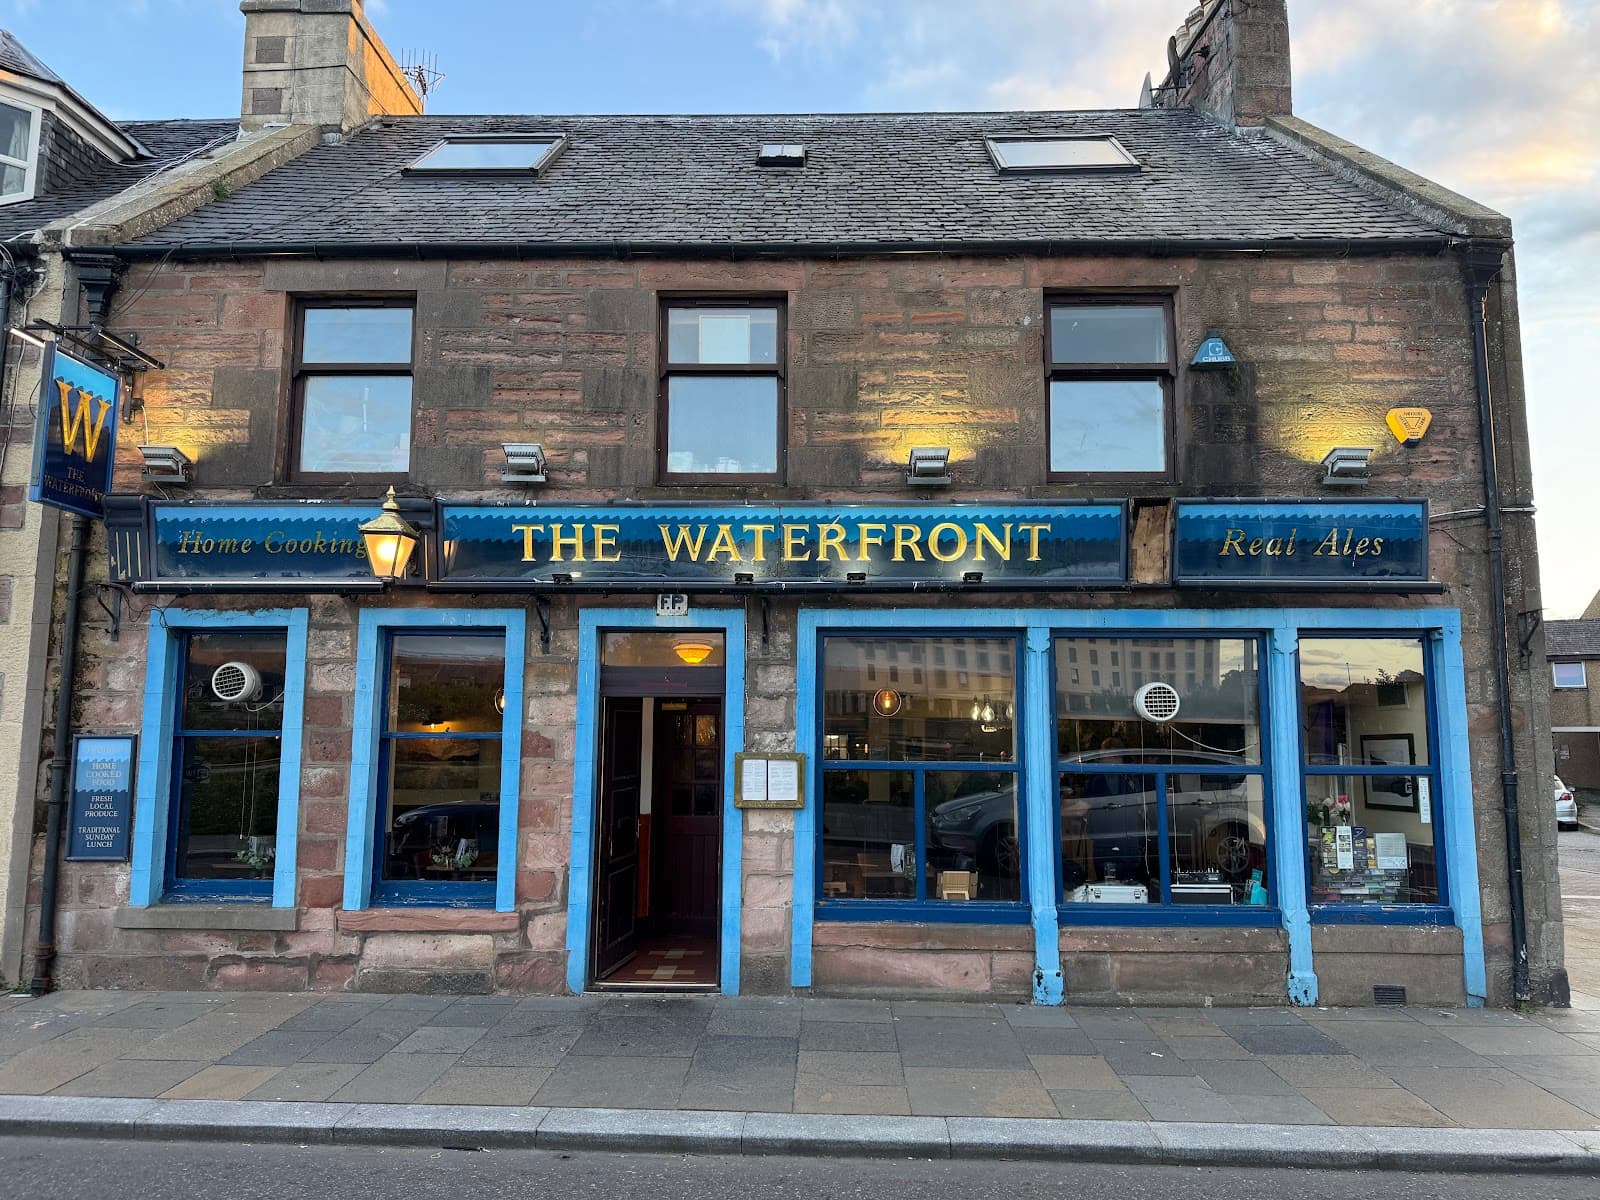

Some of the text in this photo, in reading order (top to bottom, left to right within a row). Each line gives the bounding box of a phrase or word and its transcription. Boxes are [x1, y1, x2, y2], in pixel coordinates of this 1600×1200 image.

[56, 379, 111, 463] W
[67, 467, 85, 482] THE
[177, 530, 368, 559] Home Cooking
[511, 522, 1051, 562] THE WATERFRONT
[1218, 527, 1384, 556] Real Ales
[92, 762, 117, 770] HOME
